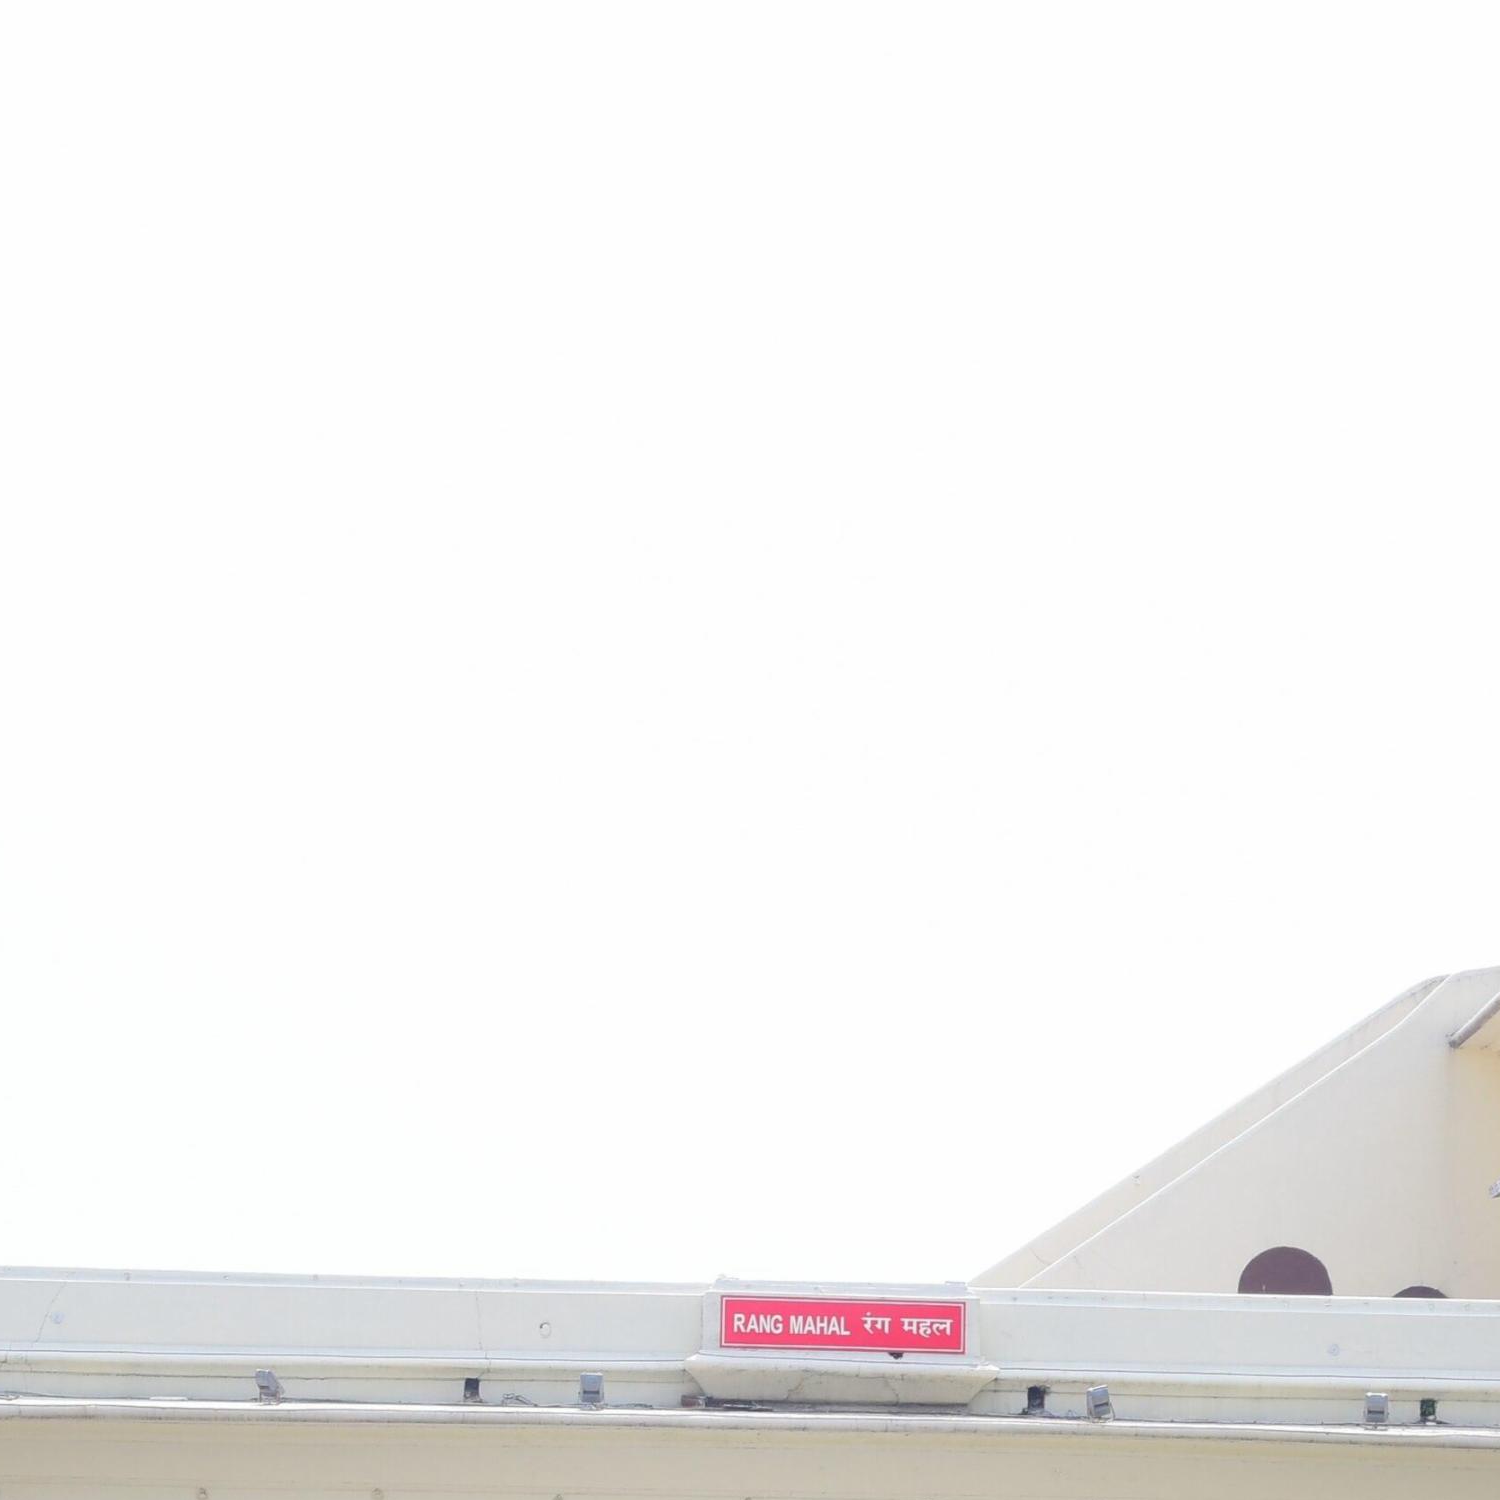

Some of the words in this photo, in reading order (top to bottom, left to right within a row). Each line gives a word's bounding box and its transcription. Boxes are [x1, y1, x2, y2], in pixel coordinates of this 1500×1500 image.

[733, 1313, 783, 1334] RANG
[789, 1315, 851, 1336] MAHAL
[862, 1311, 891, 1335] रंग
[900, 1317, 953, 1338] महल
